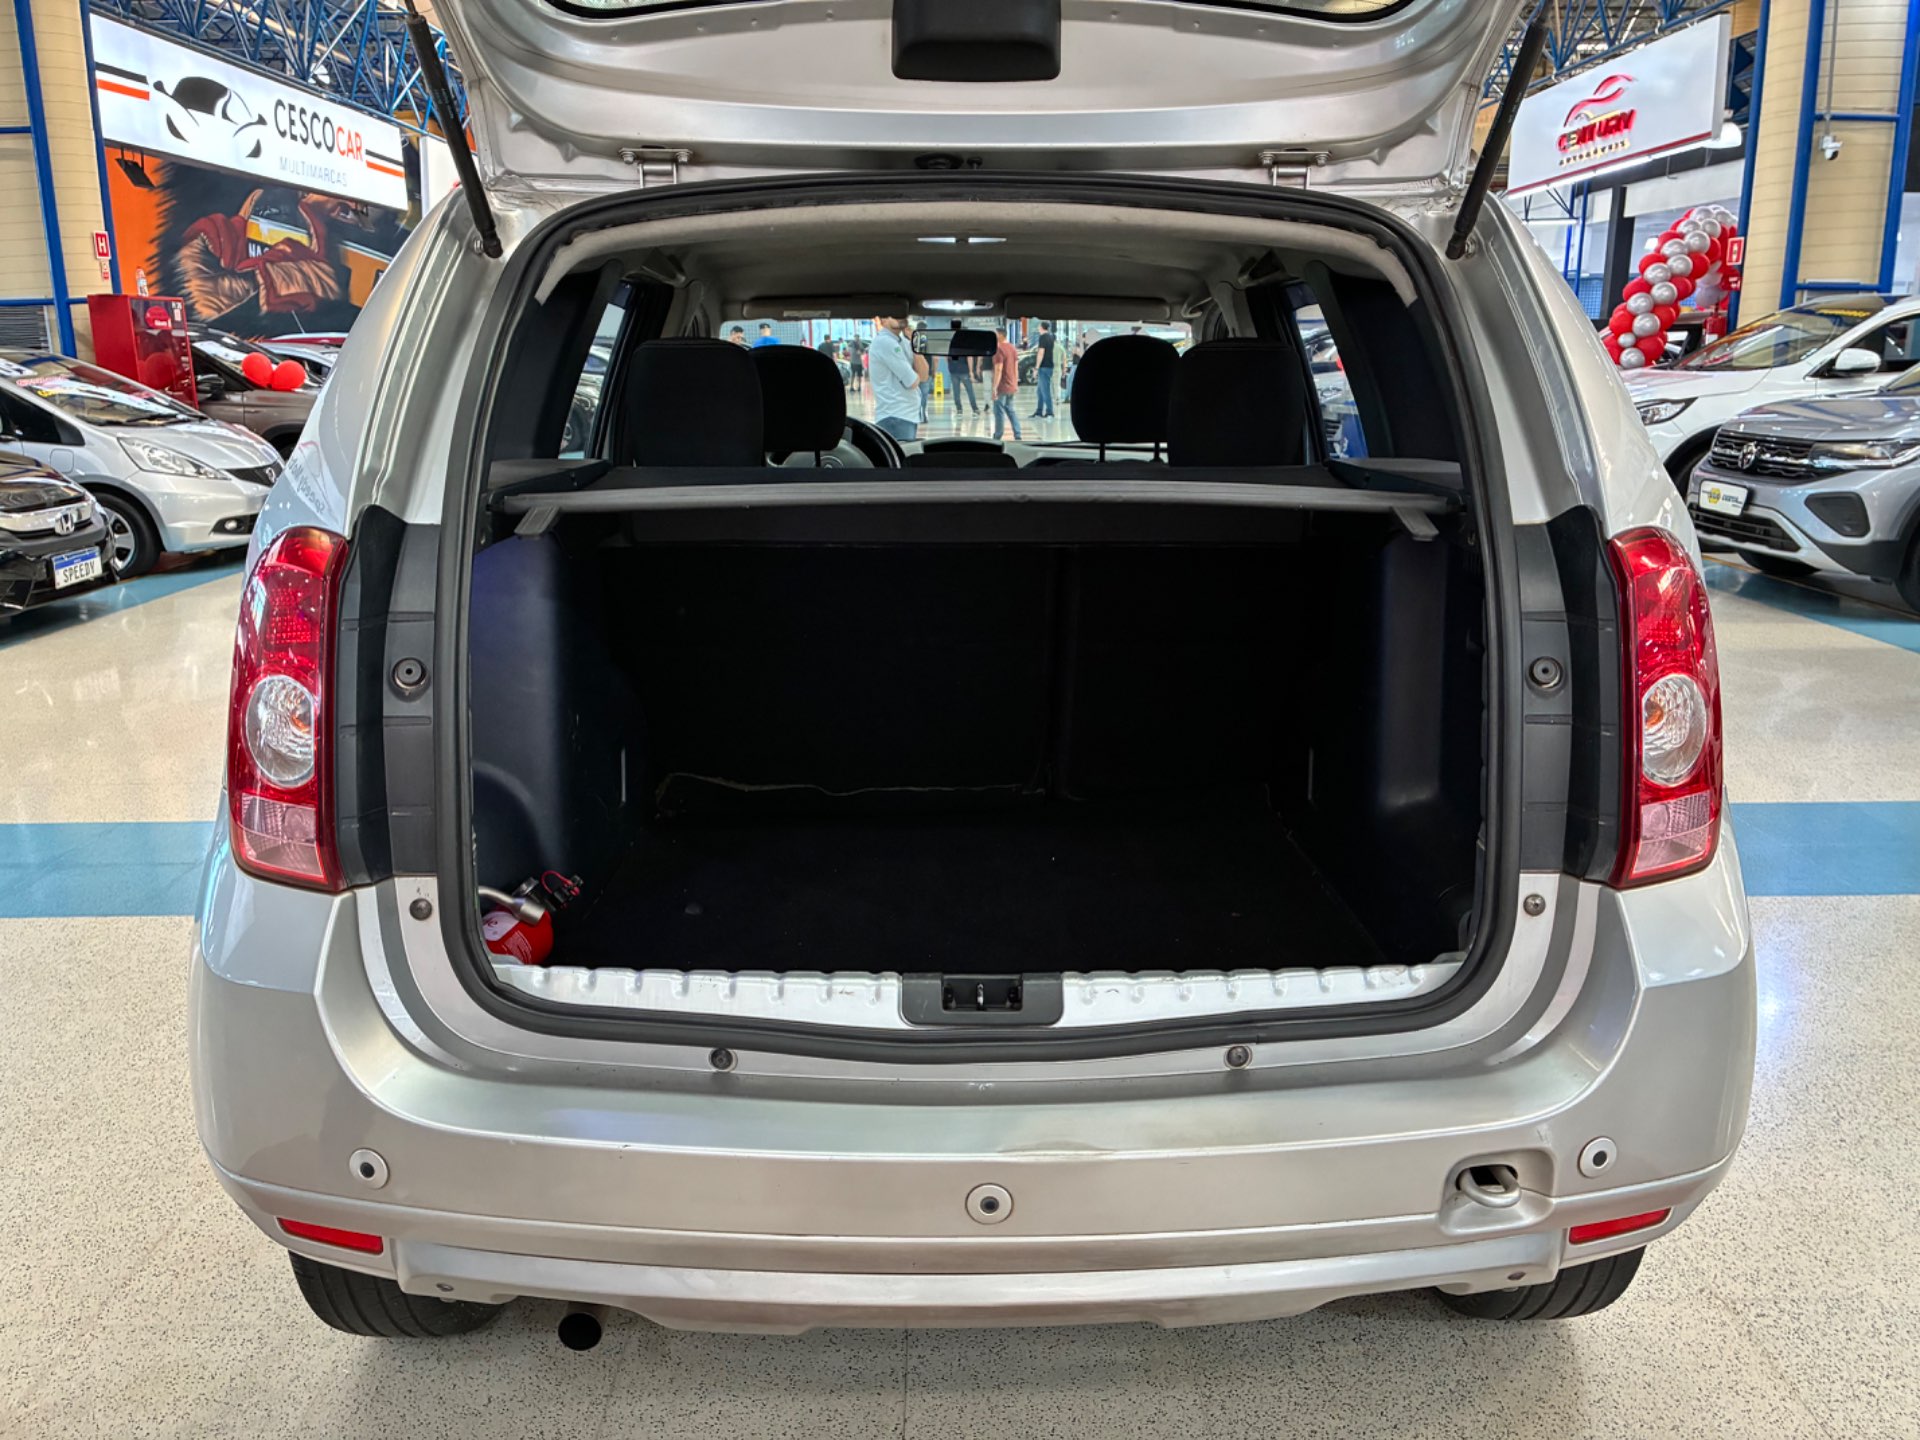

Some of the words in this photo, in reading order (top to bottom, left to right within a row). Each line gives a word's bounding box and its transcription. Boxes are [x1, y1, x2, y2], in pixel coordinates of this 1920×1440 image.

[274, 98, 363, 161] CESCOCAR
[1557, 109, 1636, 152] CENTURY
[279, 156, 347, 187] MULTIMARCAS
[63, 560, 95, 583] SPEEDY
